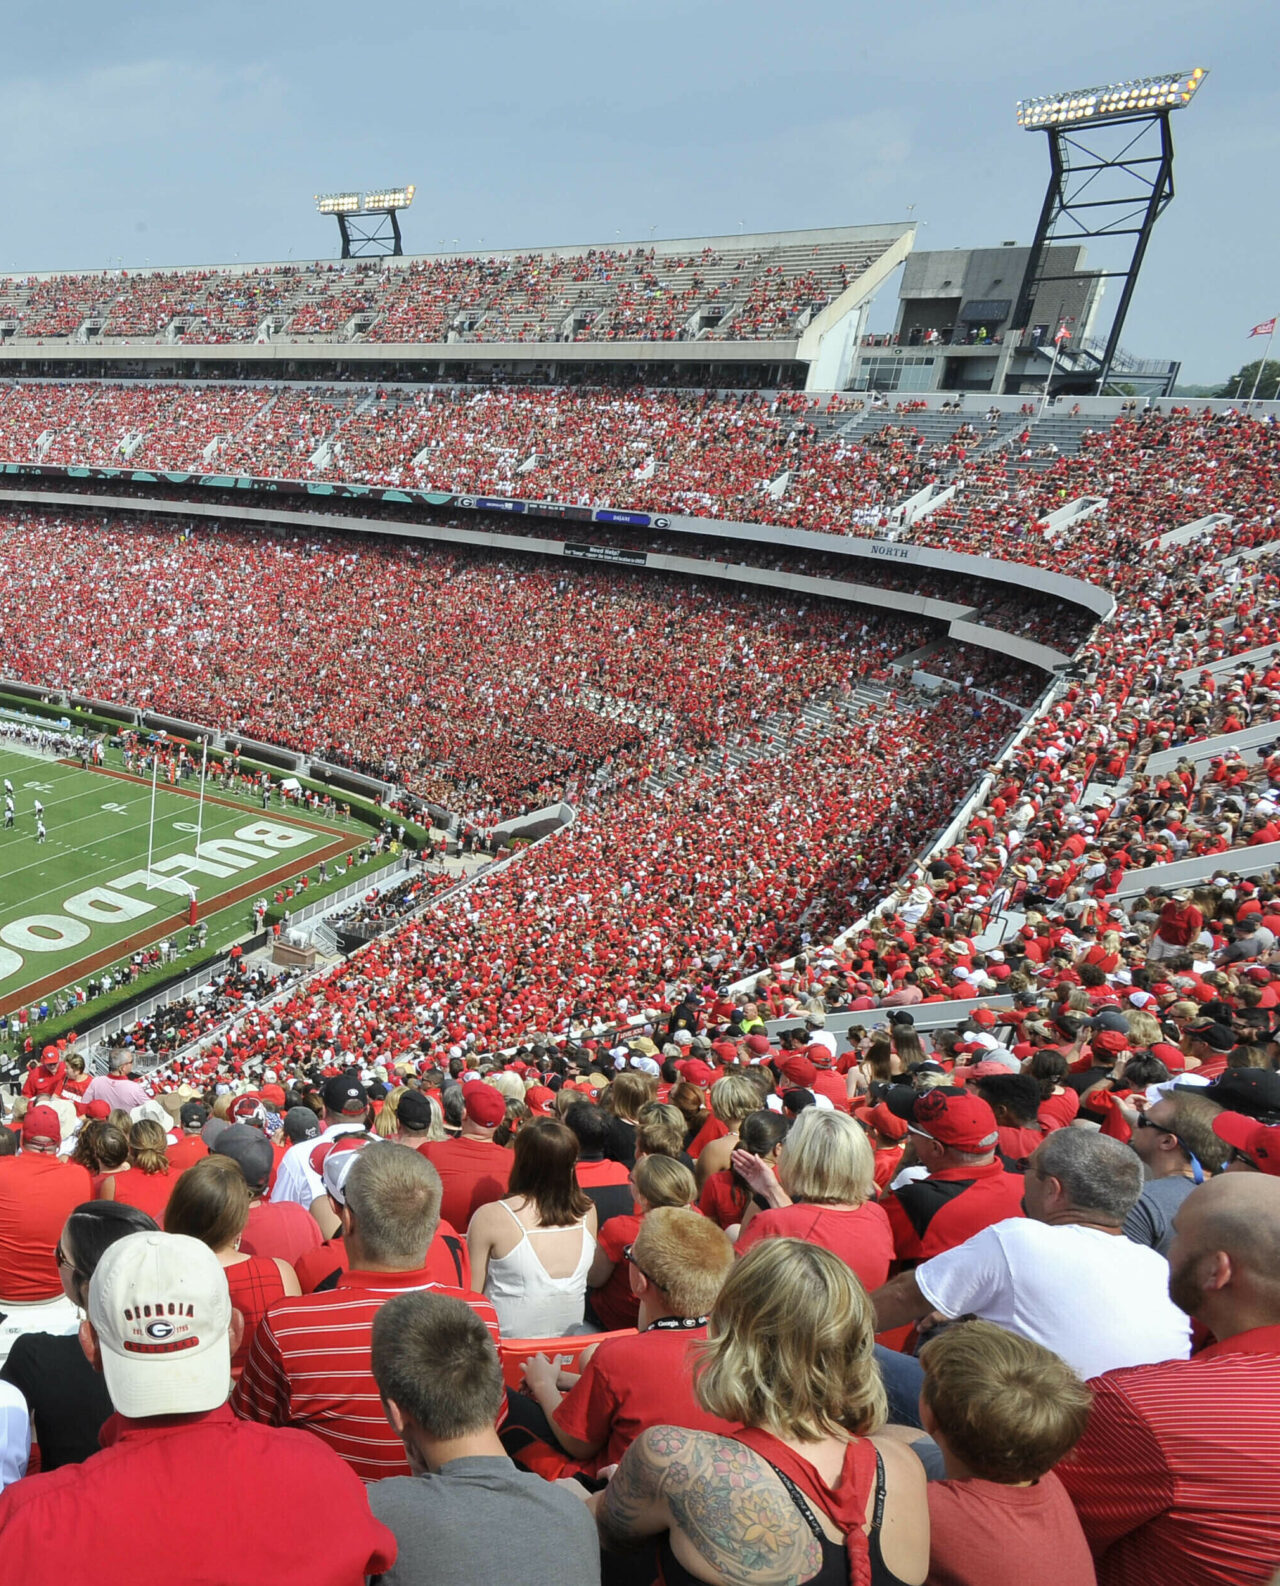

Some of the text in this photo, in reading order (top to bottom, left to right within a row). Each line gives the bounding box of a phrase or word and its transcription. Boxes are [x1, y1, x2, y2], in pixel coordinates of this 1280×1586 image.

[871, 545, 908, 558] NORTH
[124, 1302, 194, 1321] GEORGIA
[657, 1319, 679, 1328] Georgia
